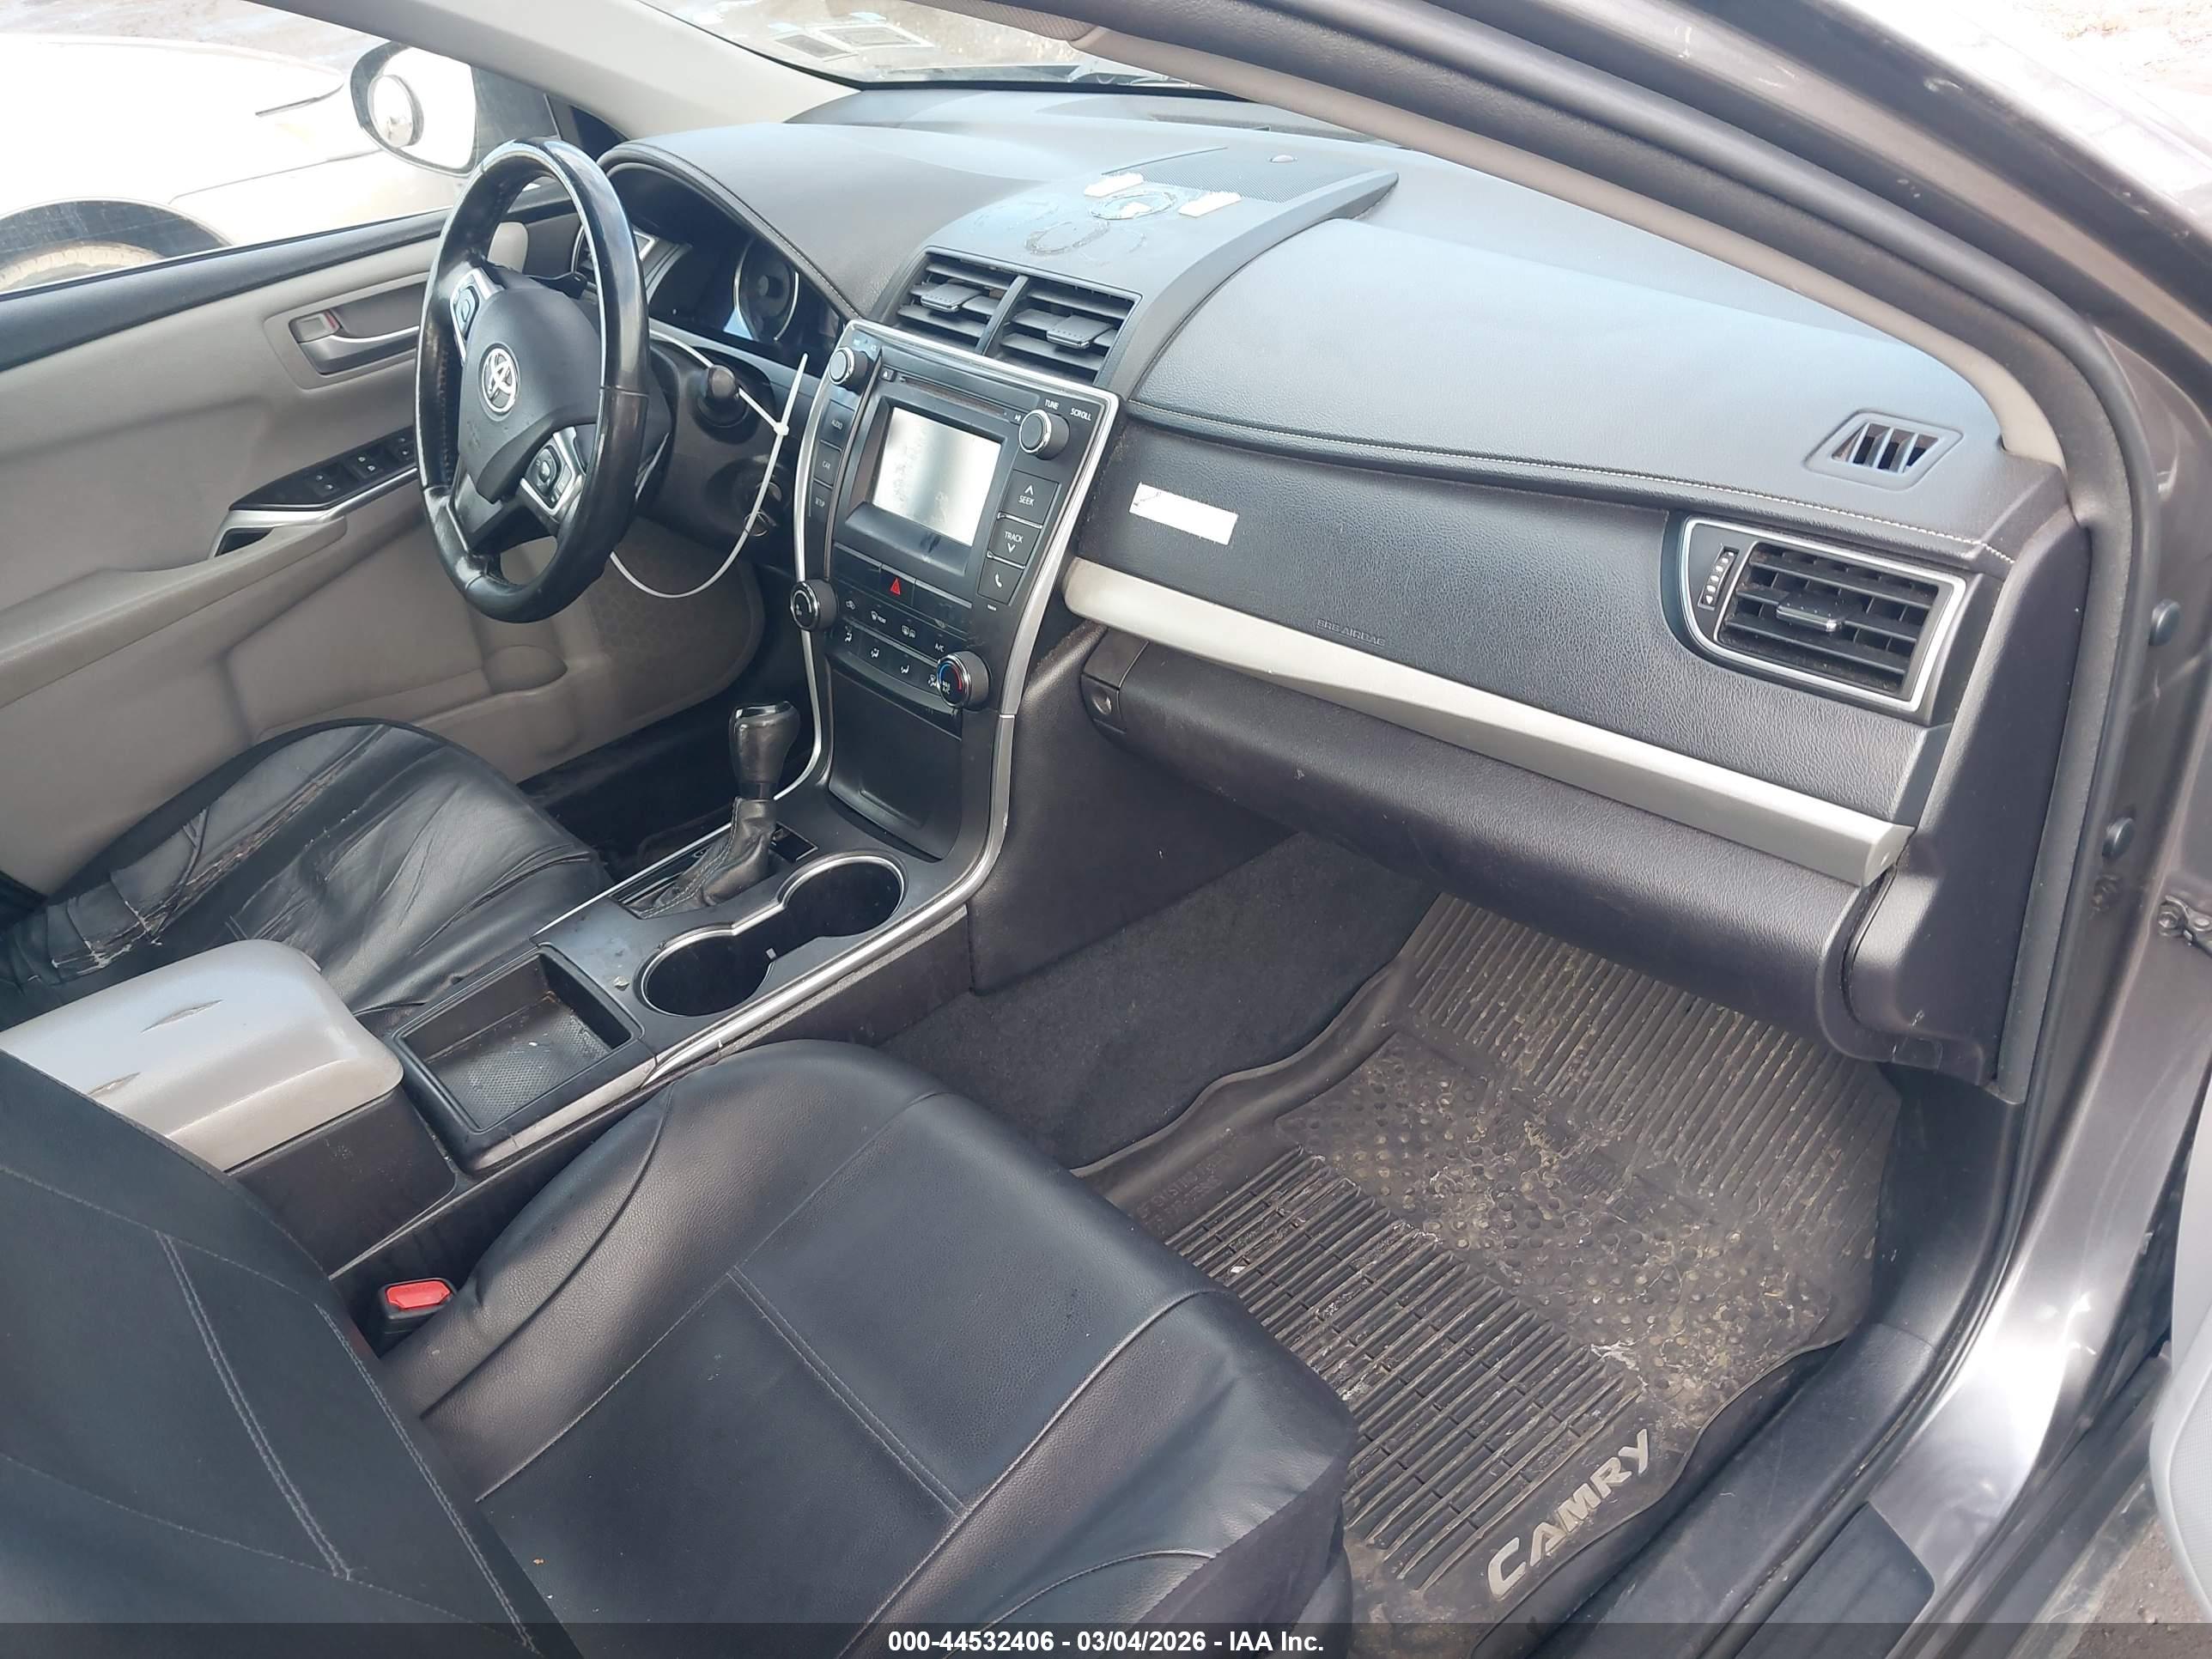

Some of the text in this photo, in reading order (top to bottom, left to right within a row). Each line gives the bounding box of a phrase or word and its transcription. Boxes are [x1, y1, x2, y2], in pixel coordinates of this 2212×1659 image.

[1045, 398, 1060, 410] TUNE
[1070, 408, 1091, 422] SCROLL
[821, 460, 831, 471] CAR
[1018, 495, 1035, 507] SEEK
[1005, 531, 1024, 544] TRACK
[1341, 627, 1386, 646] AIRBAG
[935, 643, 945, 653] A/C
[1487, 1428, 1650, 1600] CAMRY
